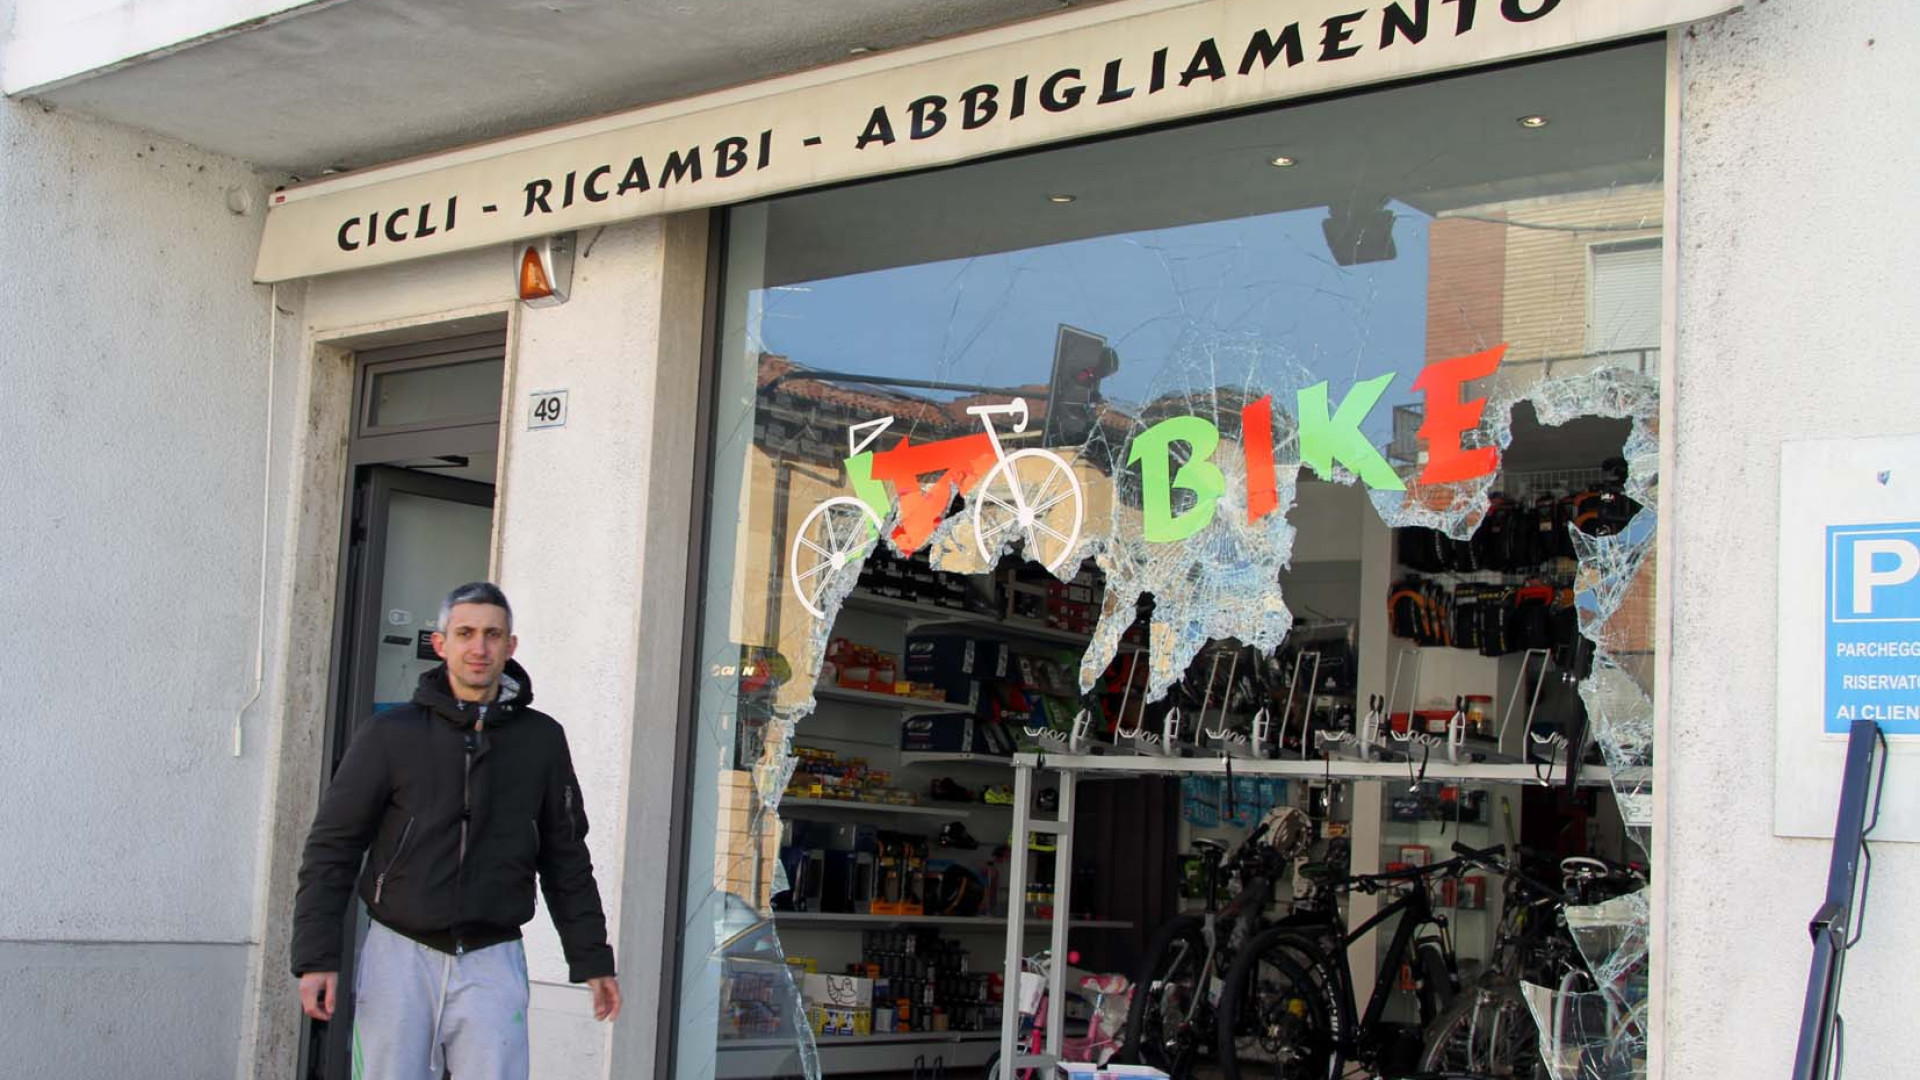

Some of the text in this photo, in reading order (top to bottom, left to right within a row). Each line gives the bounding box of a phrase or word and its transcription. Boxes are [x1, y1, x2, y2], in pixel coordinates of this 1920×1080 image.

[337, 195, 457, 252] CICLI
[523, 128, 773, 217] RICAMBI
[534, 396, 562, 421] 49
[1126, 343, 1508, 542] BIKE
[1853, 539, 1920, 614] P
[1836, 704, 1856, 720] AI
